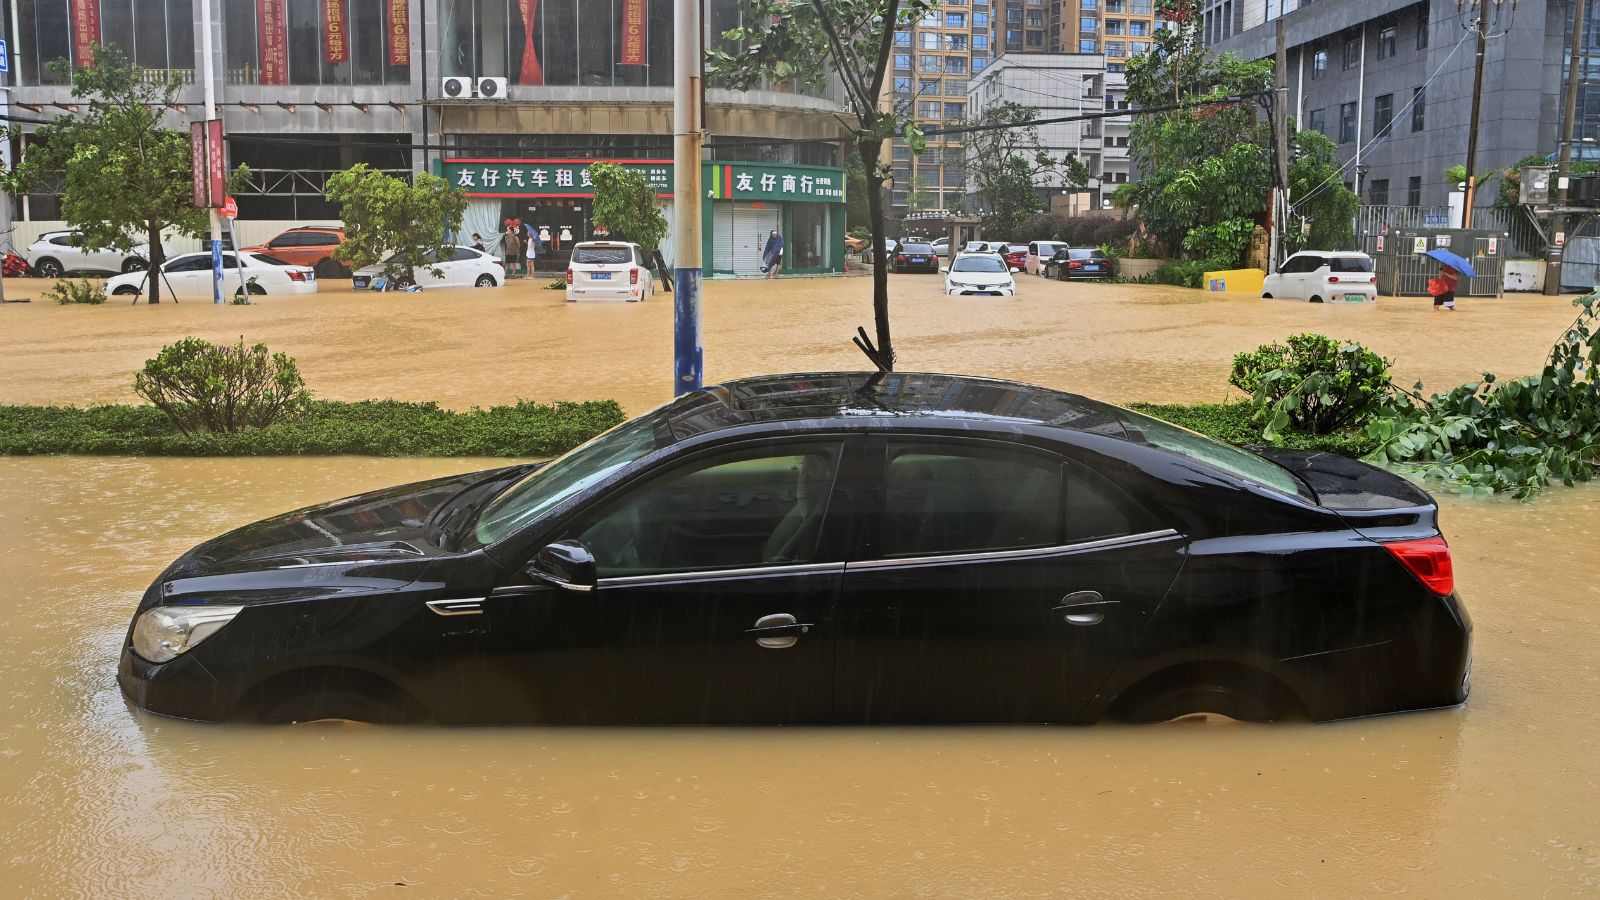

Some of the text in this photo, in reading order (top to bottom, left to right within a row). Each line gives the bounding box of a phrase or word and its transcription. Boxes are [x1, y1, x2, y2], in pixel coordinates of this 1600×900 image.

[327, 0, 344, 60] 场招租6元每平方
[736, 172, 814, 194] 友仔商行
